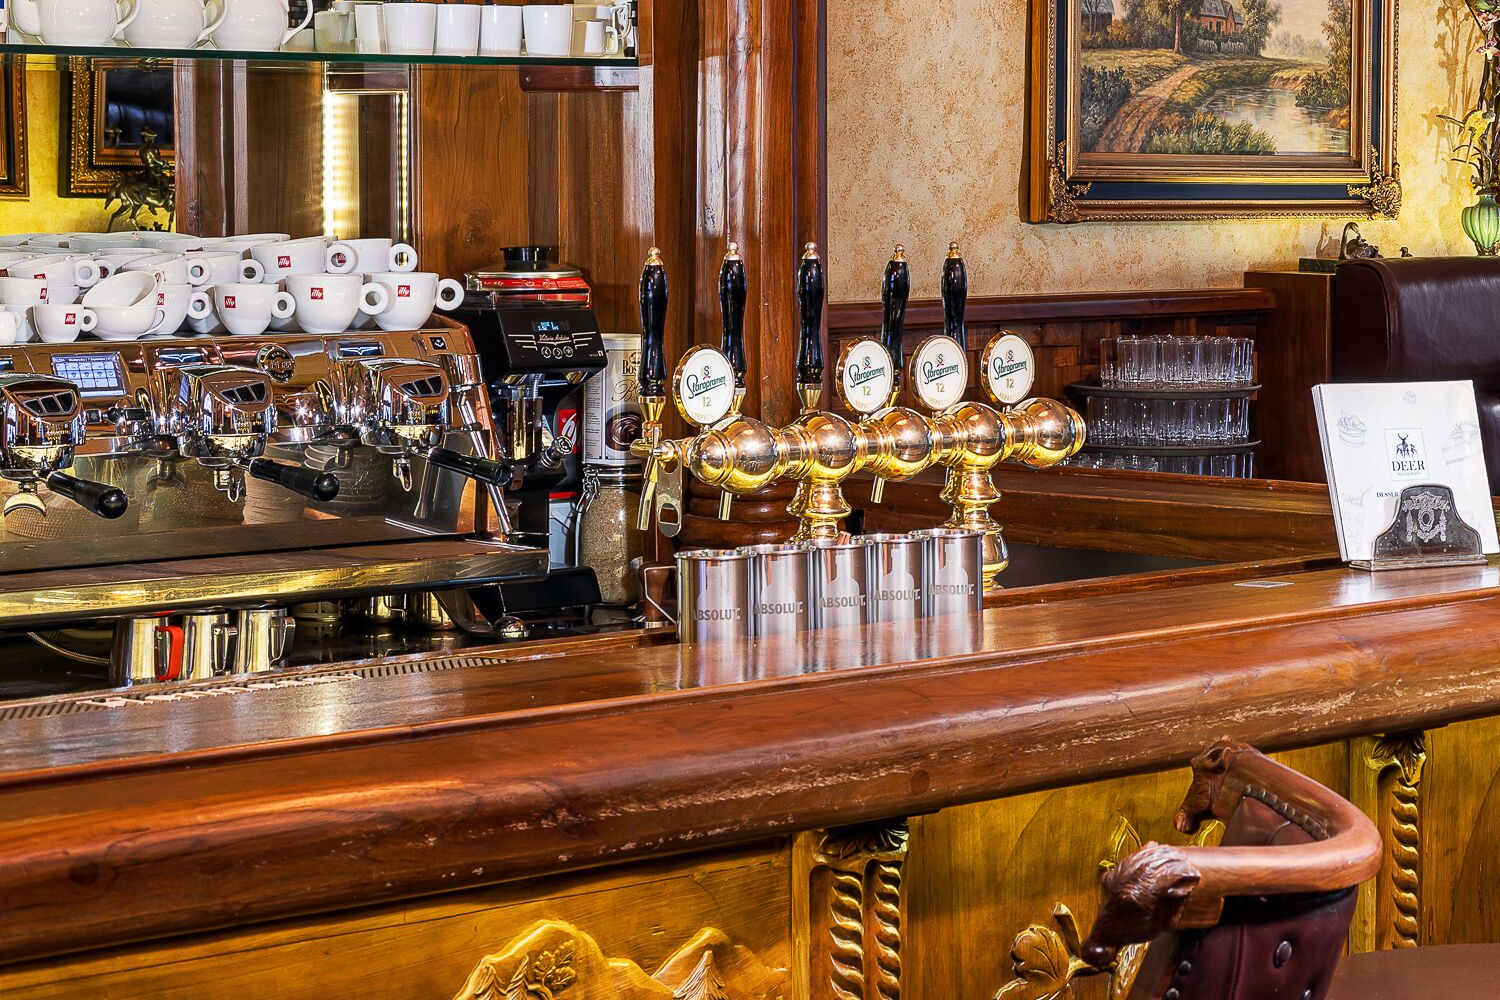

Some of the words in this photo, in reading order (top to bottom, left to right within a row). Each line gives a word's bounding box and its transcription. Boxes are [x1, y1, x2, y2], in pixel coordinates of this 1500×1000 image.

[311, 289, 323, 299] illy
[398, 286, 409, 296] illy
[226, 297, 236, 307] illy
[923, 361, 959, 385] Staropramen
[993, 357, 1028, 380] Staropramen
[848, 364, 885, 388] Staropramen
[686, 374, 726, 400] Staropramen
[936, 382, 945, 393] 12
[1005, 378, 1015, 389] 12
[862, 385, 872, 396] 12
[701, 396, 712, 407] 12
[1391, 460, 1425, 472] DEER
